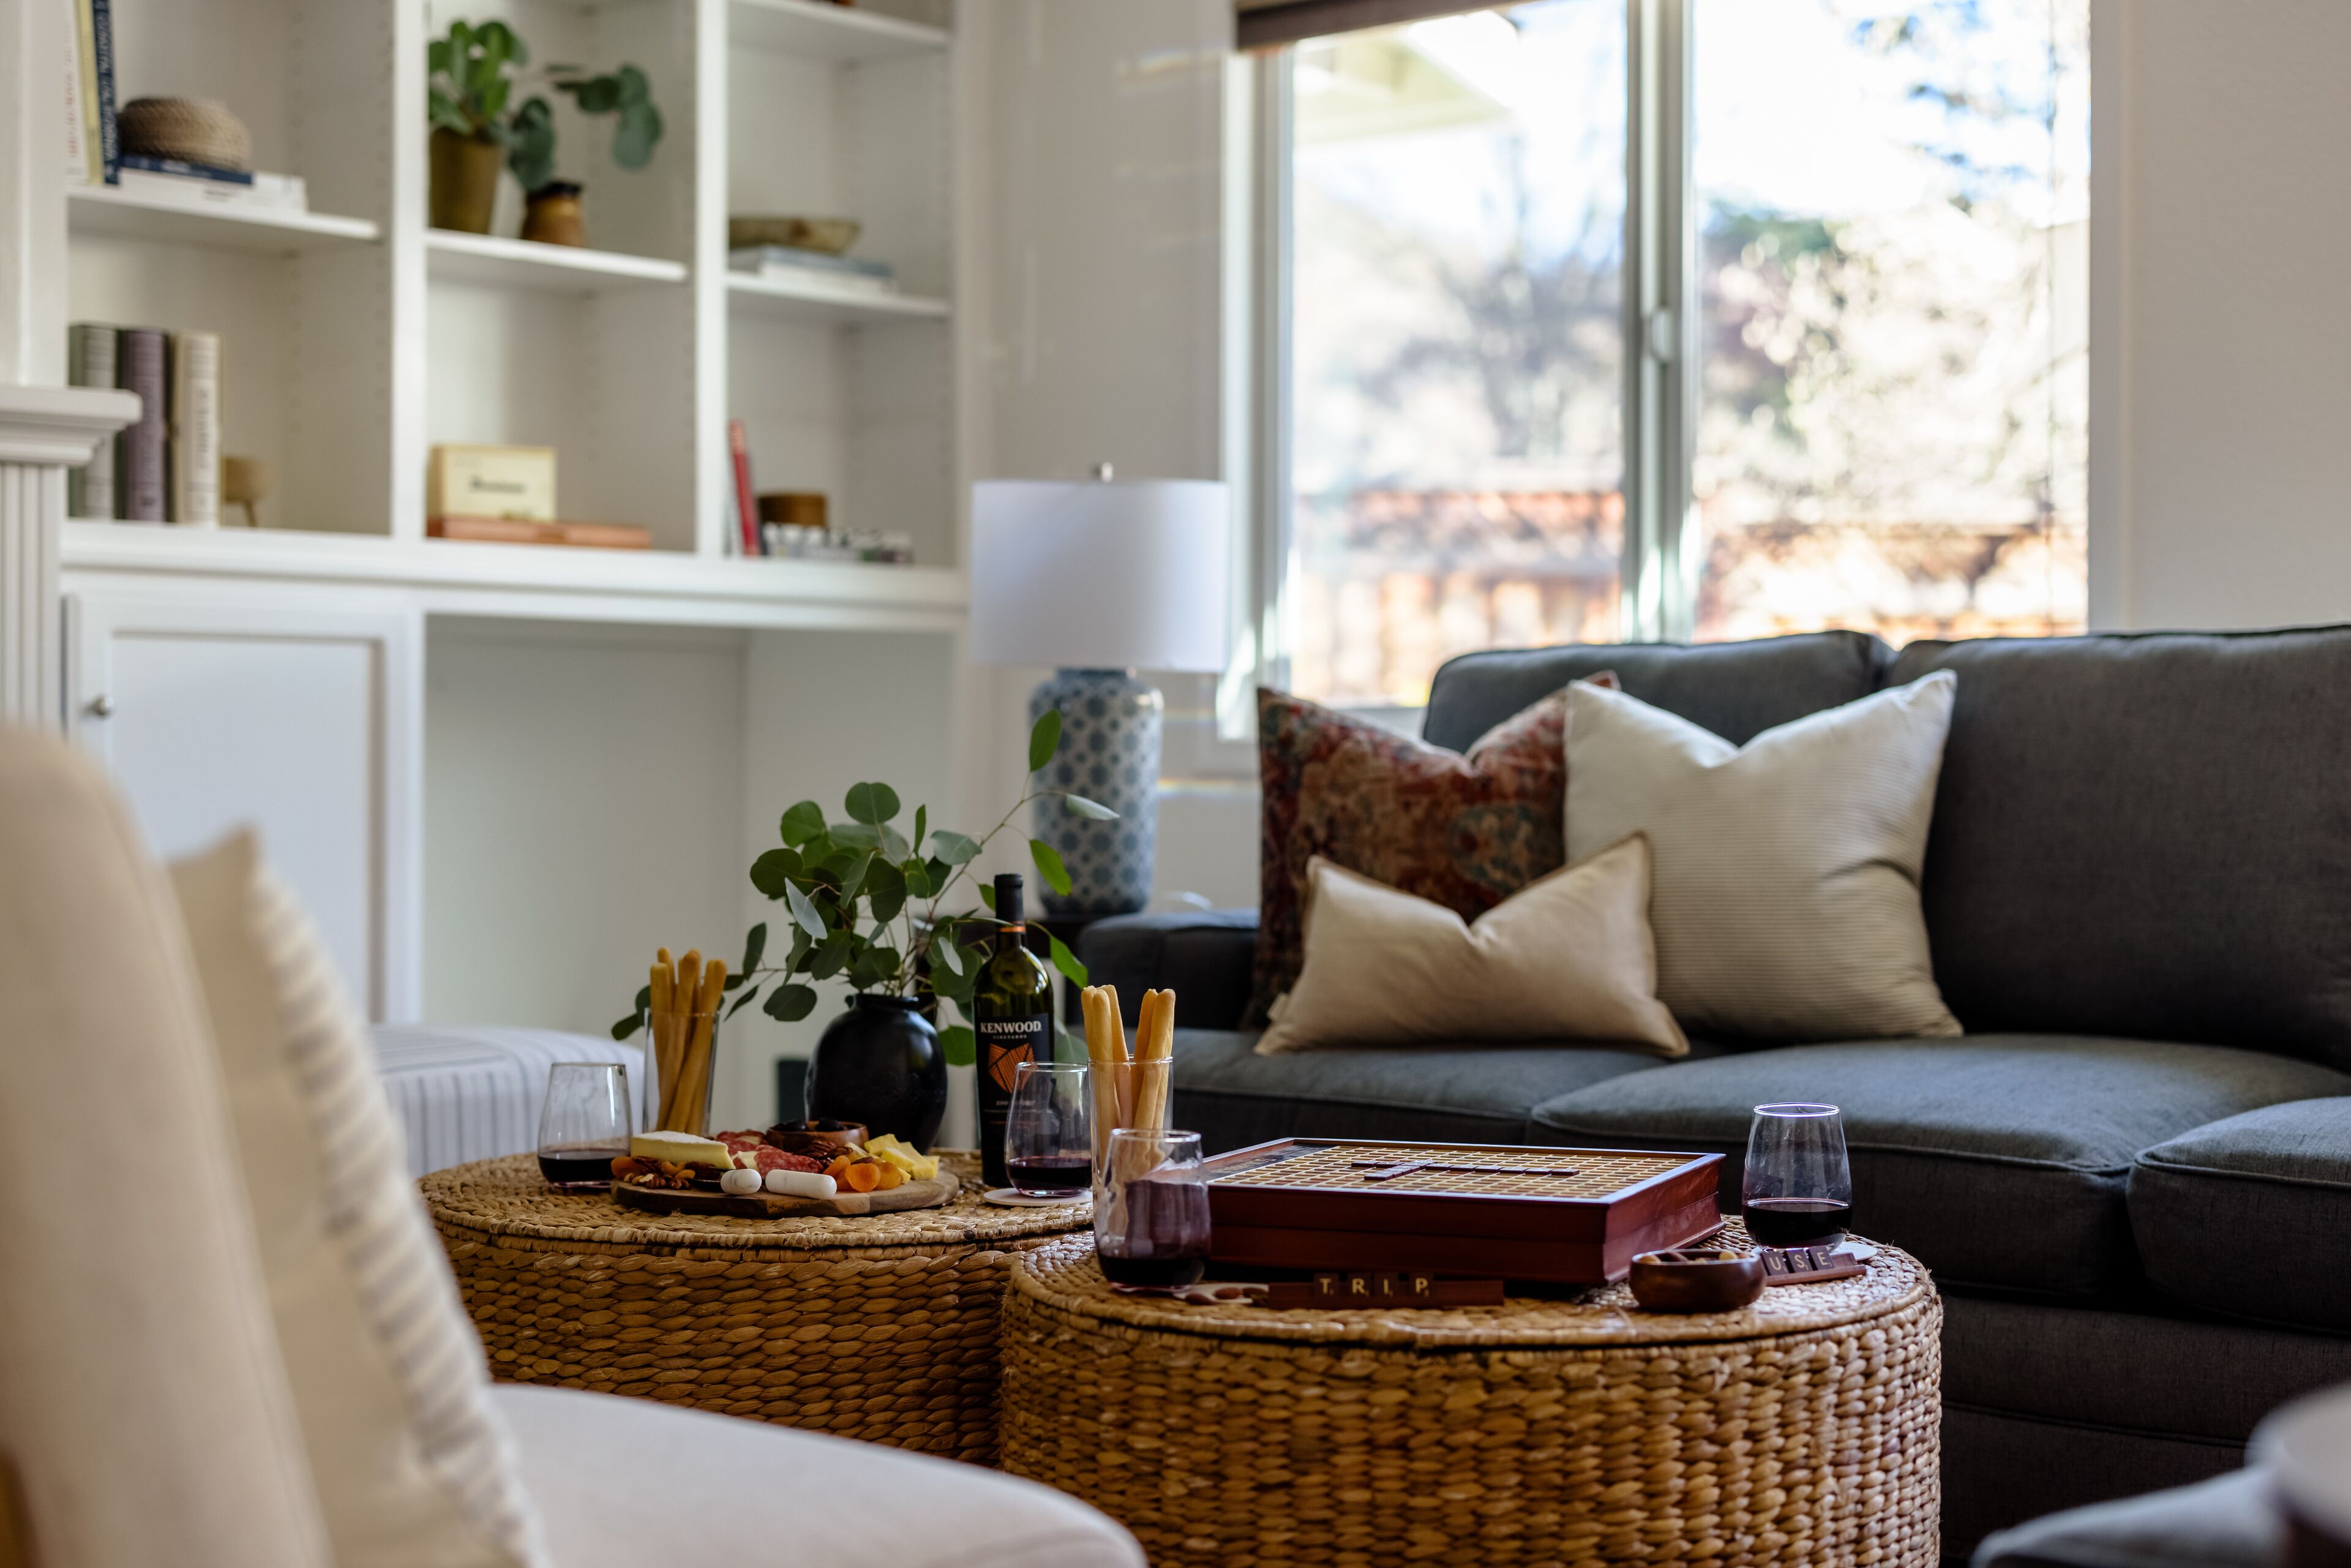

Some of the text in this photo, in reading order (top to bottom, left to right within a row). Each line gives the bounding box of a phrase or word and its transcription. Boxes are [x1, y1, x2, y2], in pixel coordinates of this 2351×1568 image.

[980, 1020, 1042, 1033] KENWOOD
[1769, 1252, 1828, 1271] USE
[1319, 1277, 1428, 1295] TRIP
